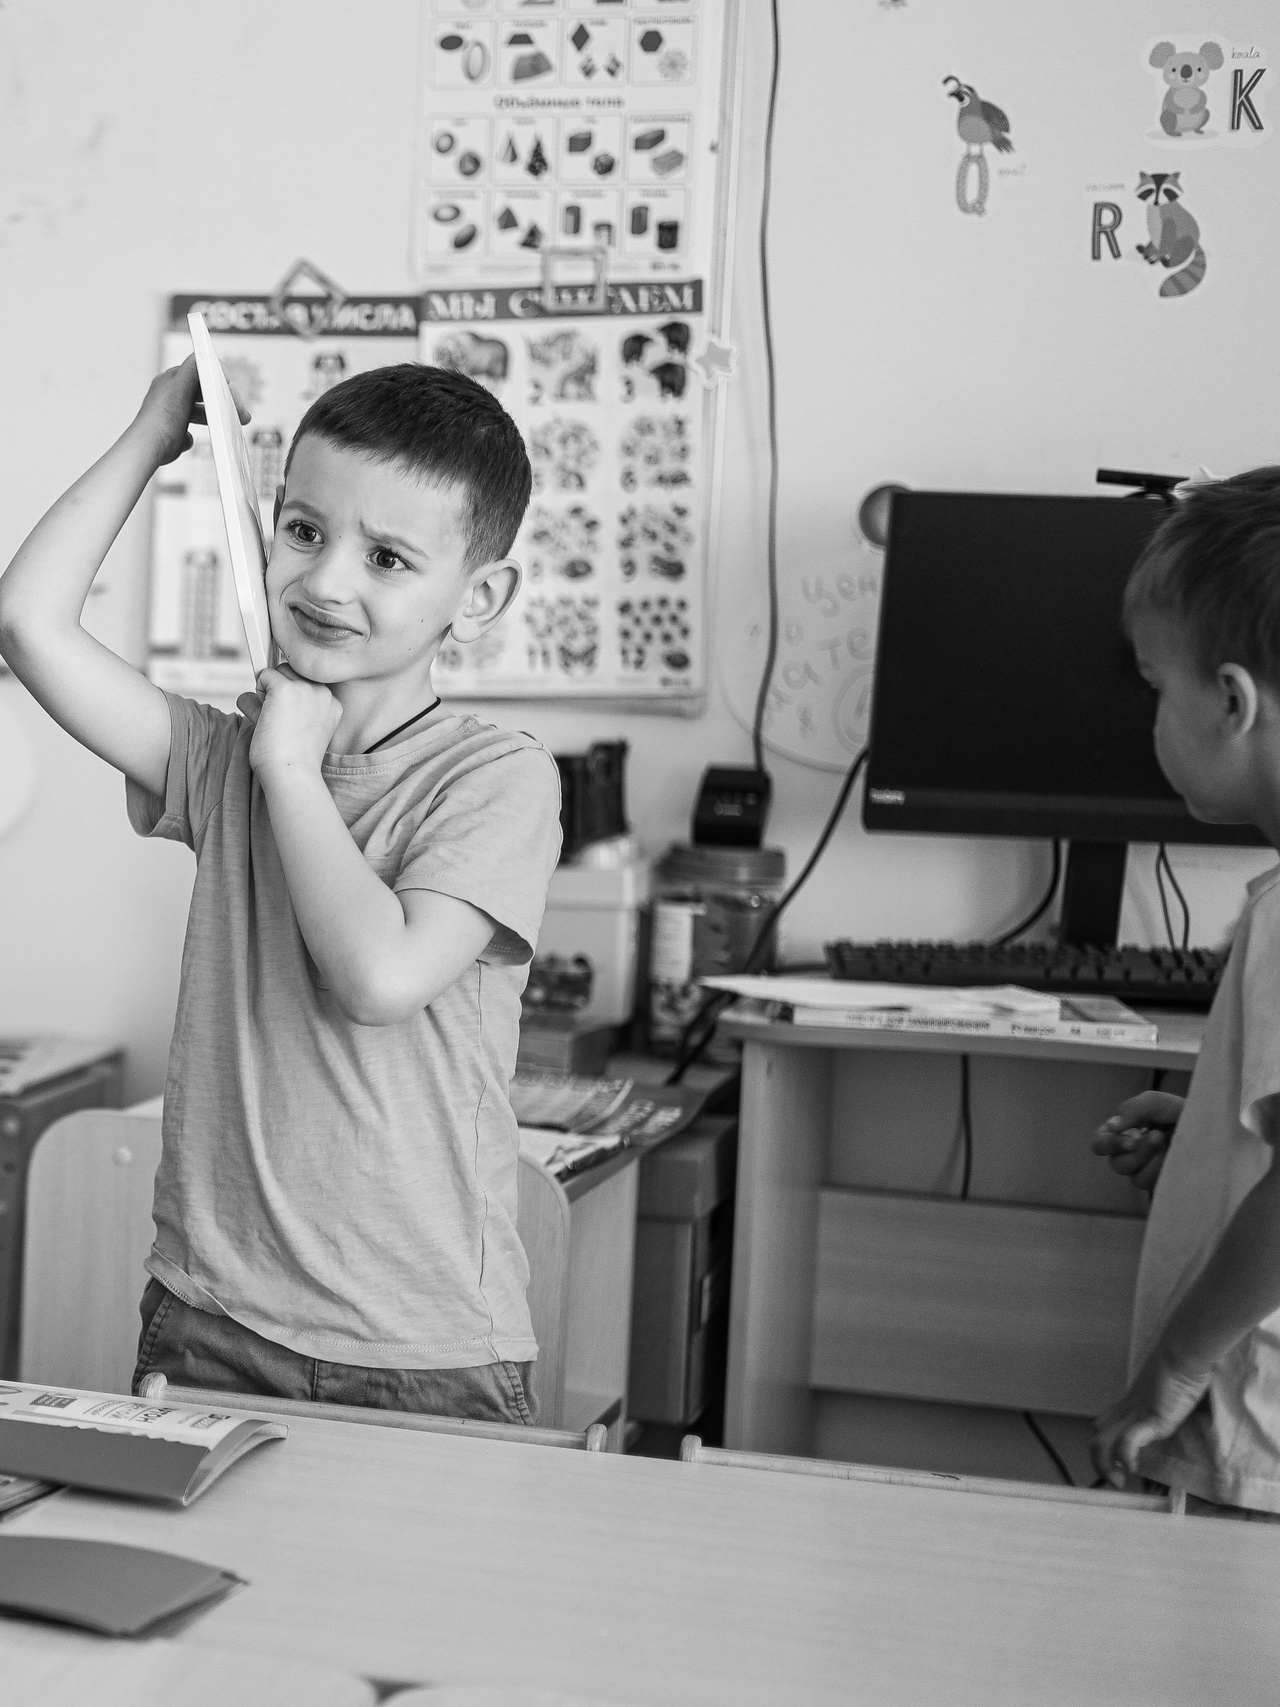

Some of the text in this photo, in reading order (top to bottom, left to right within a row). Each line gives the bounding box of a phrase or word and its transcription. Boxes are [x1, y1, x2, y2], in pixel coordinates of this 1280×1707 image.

[1232, 46, 1260, 59] koala
[1231, 68, 1267, 131] K
[956, 153, 989, 216] Q
[1091, 202, 1123, 260] R
[427, 291, 496, 320] МЫ
[528, 378, 543, 405] 2
[528, 644, 550, 671] 11
[621, 646, 646, 671] 12
